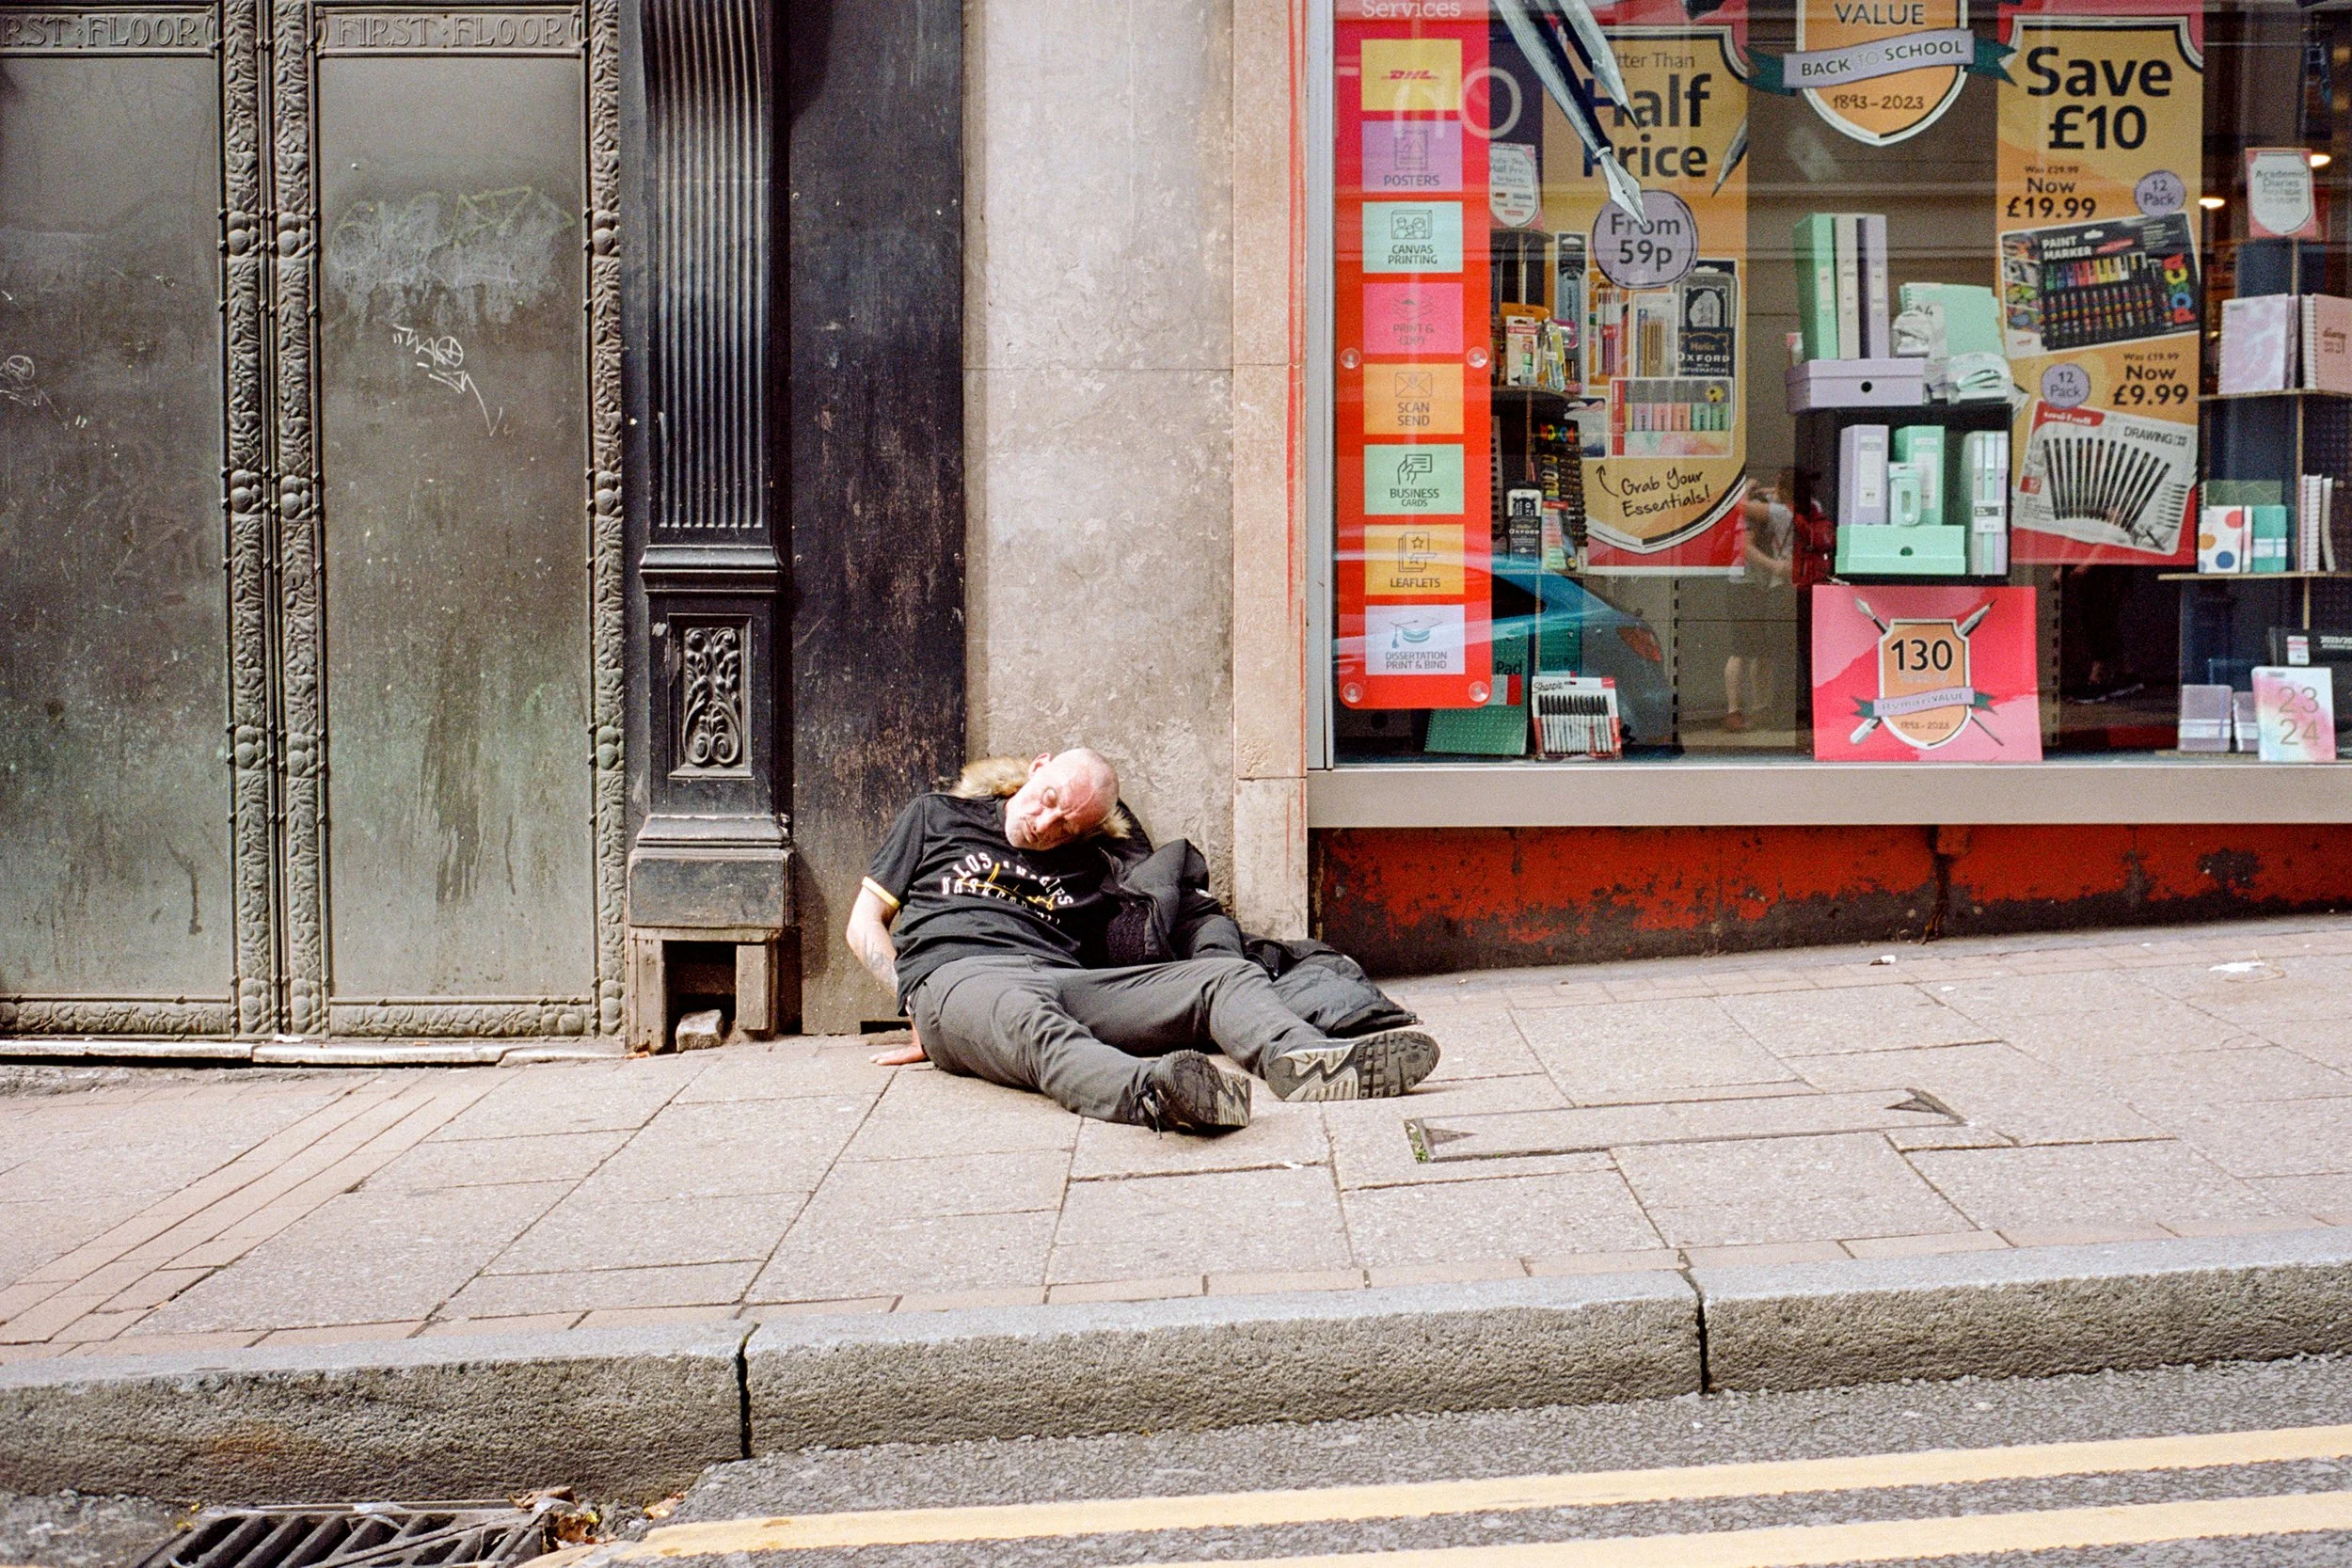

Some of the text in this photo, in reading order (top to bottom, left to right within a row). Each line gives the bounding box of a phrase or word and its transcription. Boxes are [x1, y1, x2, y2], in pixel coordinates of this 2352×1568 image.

[1361, 0, 1460, 18] Services
[1836, 4, 1925, 25] VALUE
[87, 15, 199, 47] FLOOR
[336, 15, 564, 48] FIRST FLOOR
[1615, 53, 1695, 69] tter Than
[1802, 40, 1964, 77] BACK TO SCHOOL
[1388, 69, 1433, 80] DHL
[2026, 46, 2173, 97] Save
[1583, 72, 1712, 128] Half
[2048, 104, 2147, 150] £10
[1384, 174, 1439, 186] POSTERS
[2026, 177, 2077, 194] Now
[2152, 179, 2168, 192] 12
[2006, 196, 2097, 219] £19.99
[2144, 193, 2176, 206] Pack
[1610, 213, 1681, 236] From
[1391, 245, 1434, 254] CANVAS
[2042, 235, 2078, 249] PAINT
[1388, 254, 1438, 264] PRINTING
[1618, 239, 1674, 272] 59p
[2042, 245, 2093, 261] MARKER
[1393, 324, 1424, 333] PRINT
[1677, 351, 1730, 363] OXFORD
[2058, 371, 2074, 384] 12
[2125, 364, 2177, 381] Now
[2050, 384, 2081, 399] Pack
[2113, 384, 2189, 406] £9.99
[1397, 402, 1430, 414] SCAN
[1397, 415, 1430, 426] SEND
[2123, 425, 2173, 445] DRAWING
[1620, 467, 1704, 497] Grab Your
[1390, 488, 1439, 499] BUSINESS
[1622, 483, 1711, 517] Essentials!
[1401, 499, 1428, 507] CARDS
[1390, 577, 1441, 588] LEAFLETS
[1385, 651, 1447, 659] DISSERTATION
[1890, 639, 1953, 672] 130
[1386, 660, 1447, 670] PRINT & BIND
[1496, 660, 1522, 675] Pad
[1532, 680, 1565, 694] Sharpie
[1931, 691, 1964, 703] VALUE
[2278, 686, 2320, 714] 23
[2280, 718, 2320, 747] 24
[952, 852, 992, 879] LOS
